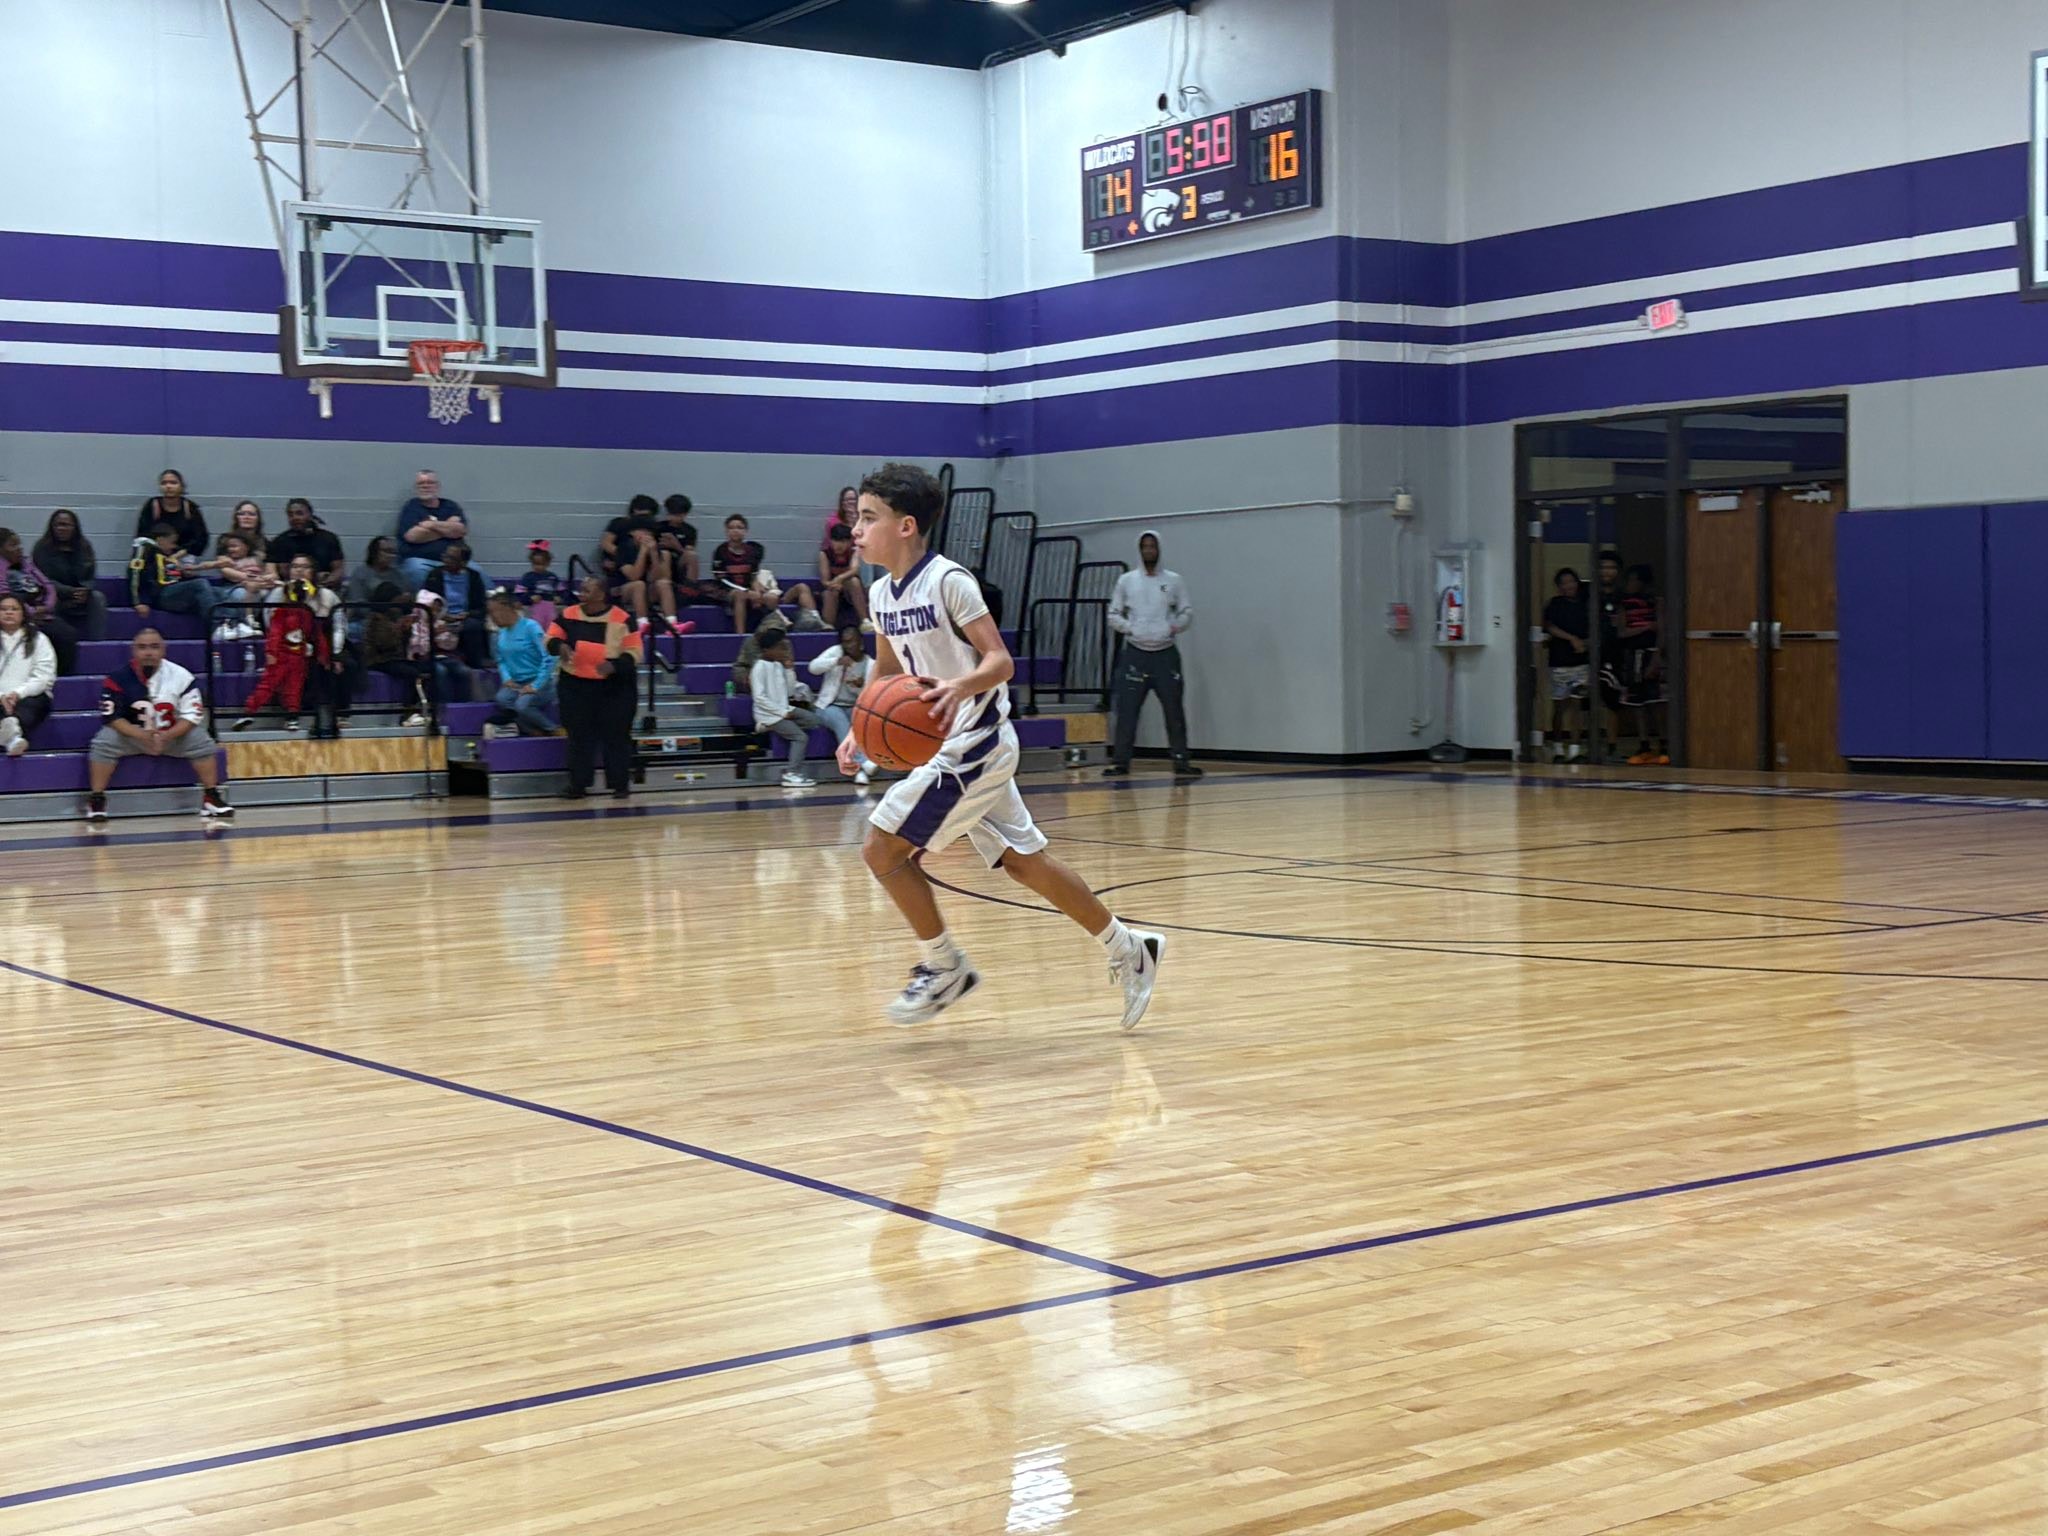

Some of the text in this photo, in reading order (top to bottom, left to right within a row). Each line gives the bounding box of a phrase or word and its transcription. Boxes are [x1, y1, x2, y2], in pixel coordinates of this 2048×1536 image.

[1249, 100, 1296, 130] VISITOR
[1084, 140, 1136, 171] WILDCATS
[1165, 116, 1231, 175] 5:50
[1269, 130, 1299, 181] 16
[1106, 168, 1132, 216] 14
[1181, 186, 1197, 220] 3
[1651, 302, 1676, 327] EXIT
